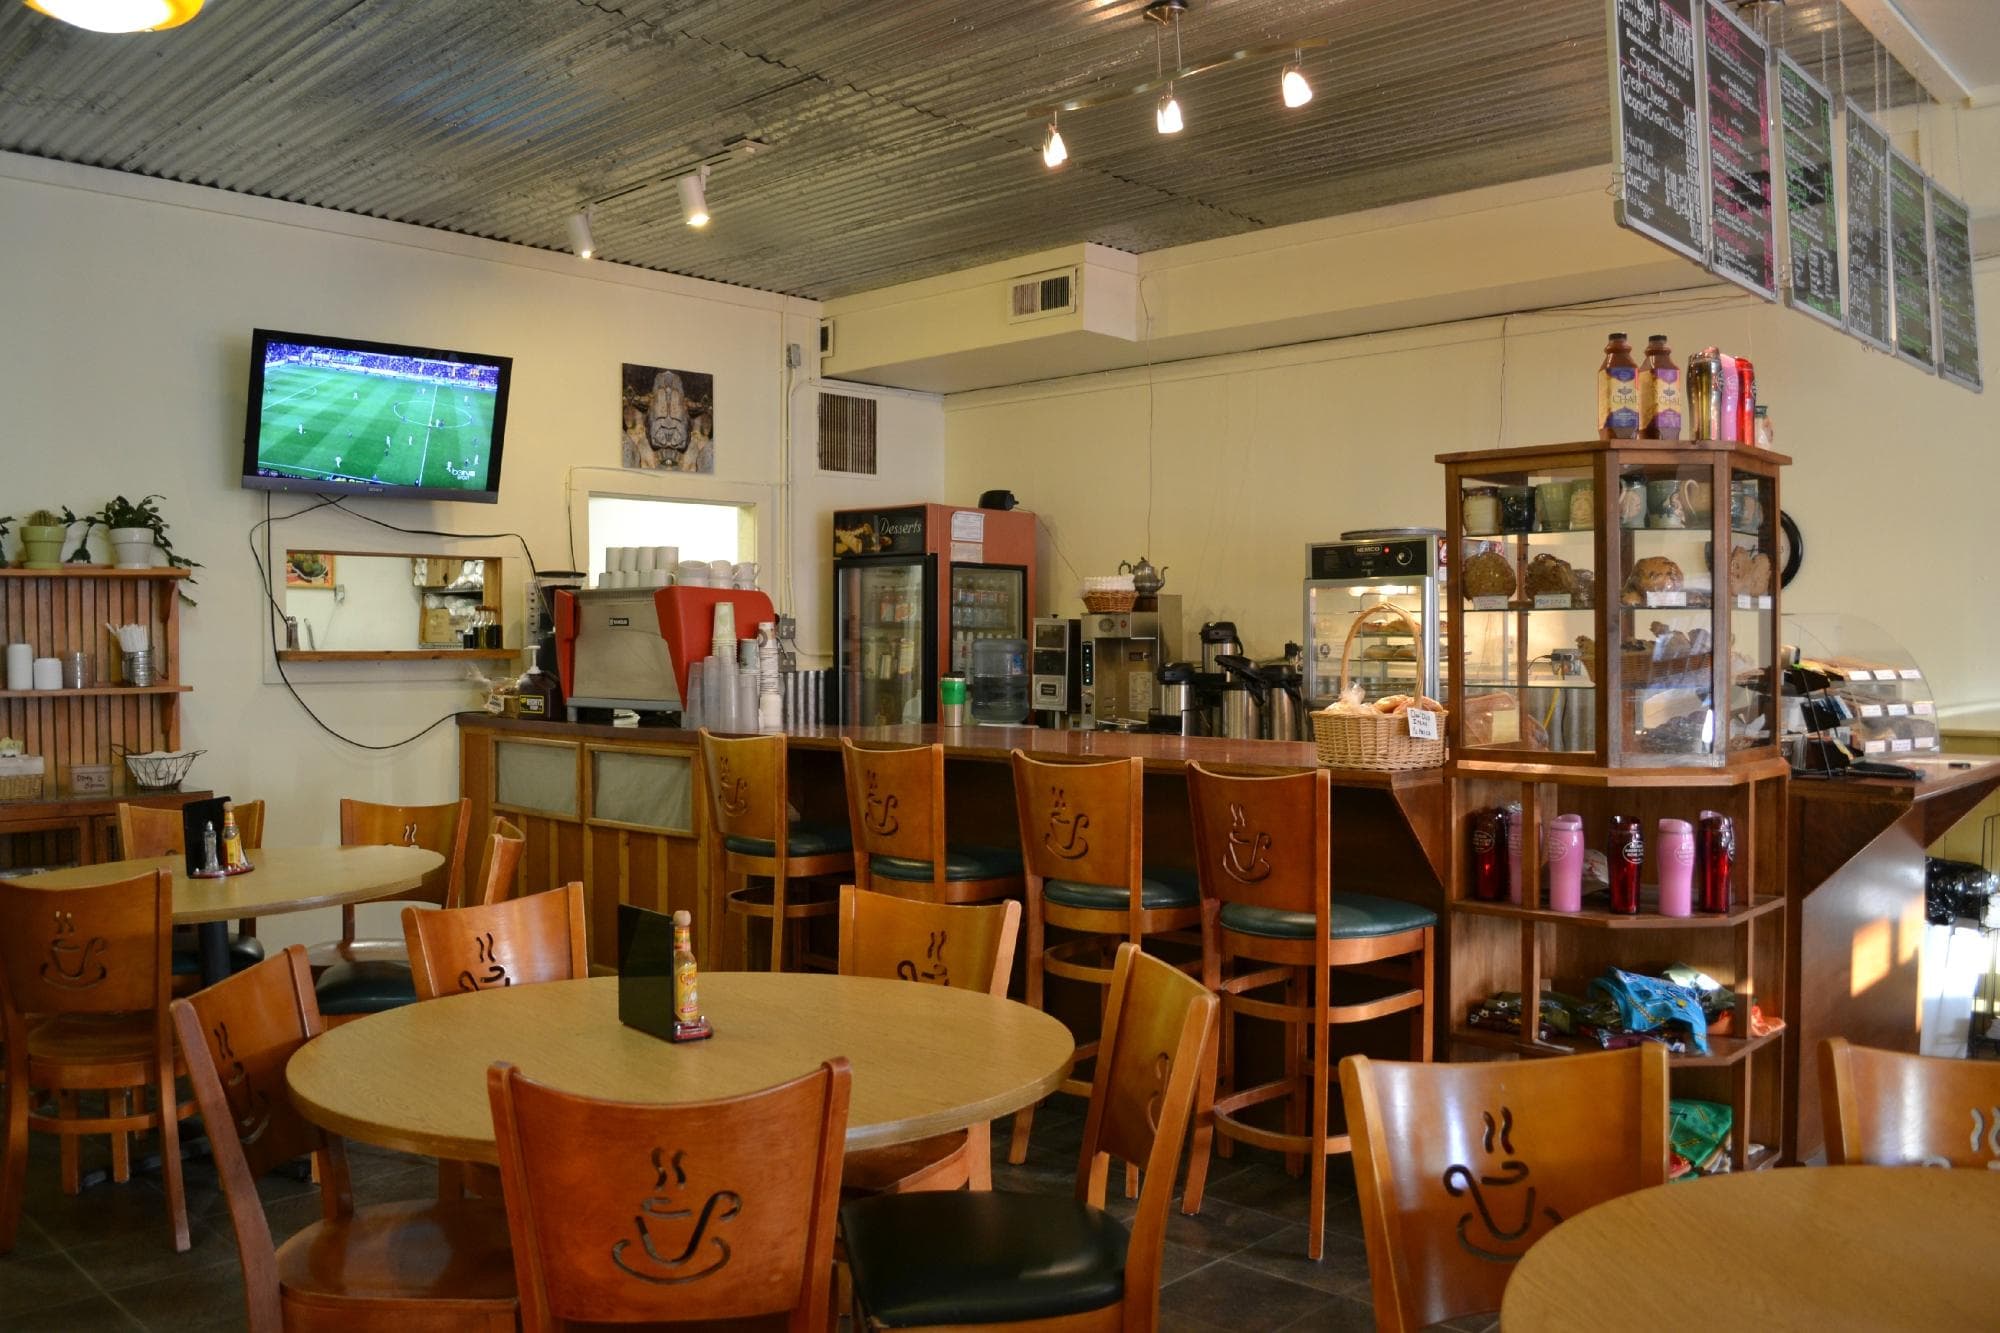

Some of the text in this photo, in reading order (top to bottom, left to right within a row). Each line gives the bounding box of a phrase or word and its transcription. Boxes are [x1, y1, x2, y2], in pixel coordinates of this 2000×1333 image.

[1612, 395, 1637, 404] CHAI
[878, 517, 923, 536] Desserts
[1356, 545, 1380, 553] NEMCO
